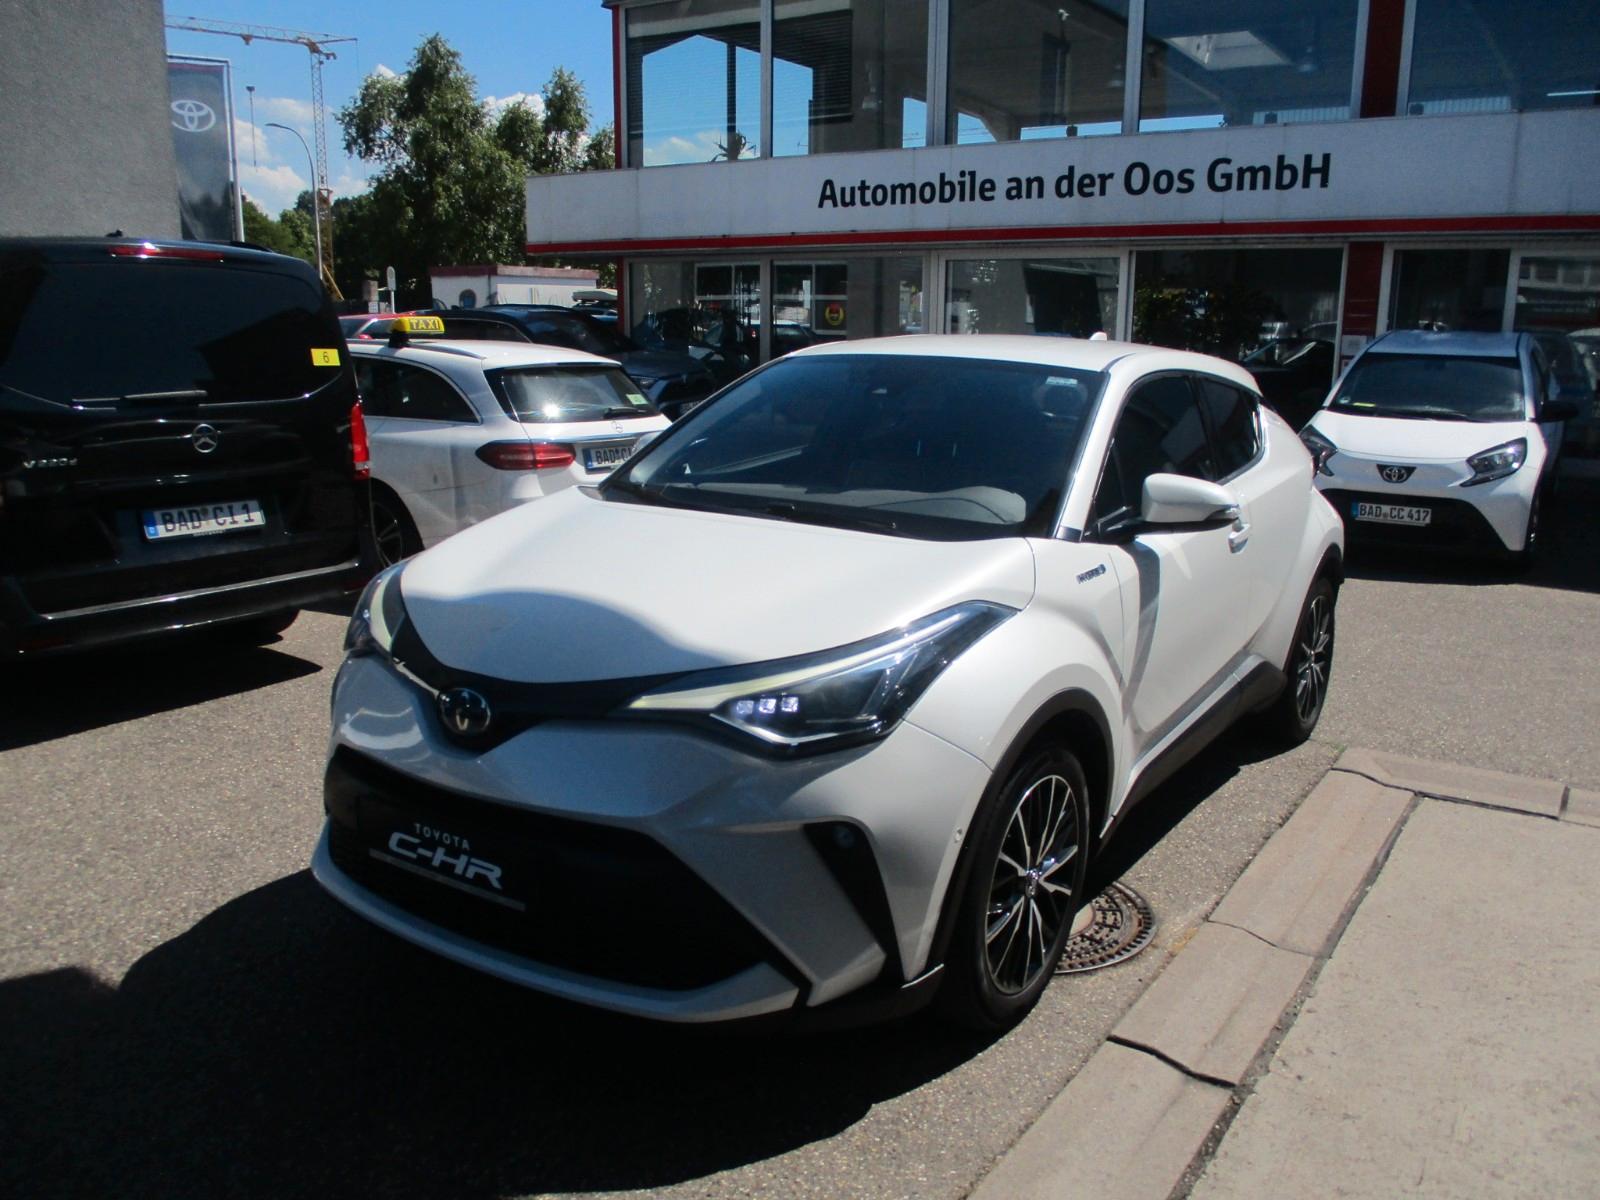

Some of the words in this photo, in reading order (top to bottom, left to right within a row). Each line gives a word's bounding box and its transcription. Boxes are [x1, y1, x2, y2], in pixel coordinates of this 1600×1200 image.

[818, 170, 996, 208] Automobile
[1005, 174, 1044, 201] an
[1054, 165, 1114, 199] der
[1124, 161, 1195, 196] Oos
[1206, 153, 1331, 192] GmbH
[410, 319, 440, 330] TAXI
[323, 351, 330, 363] 6
[595, 448, 616, 465] BAD
[161, 509, 203, 533] BAD
[1359, 504, 1382, 518] BAD
[1389, 507, 1405, 520] CC
[1407, 508, 1430, 521] 417
[414, 823, 470, 850] TOYOTA
[388, 831, 503, 890] C-HR
